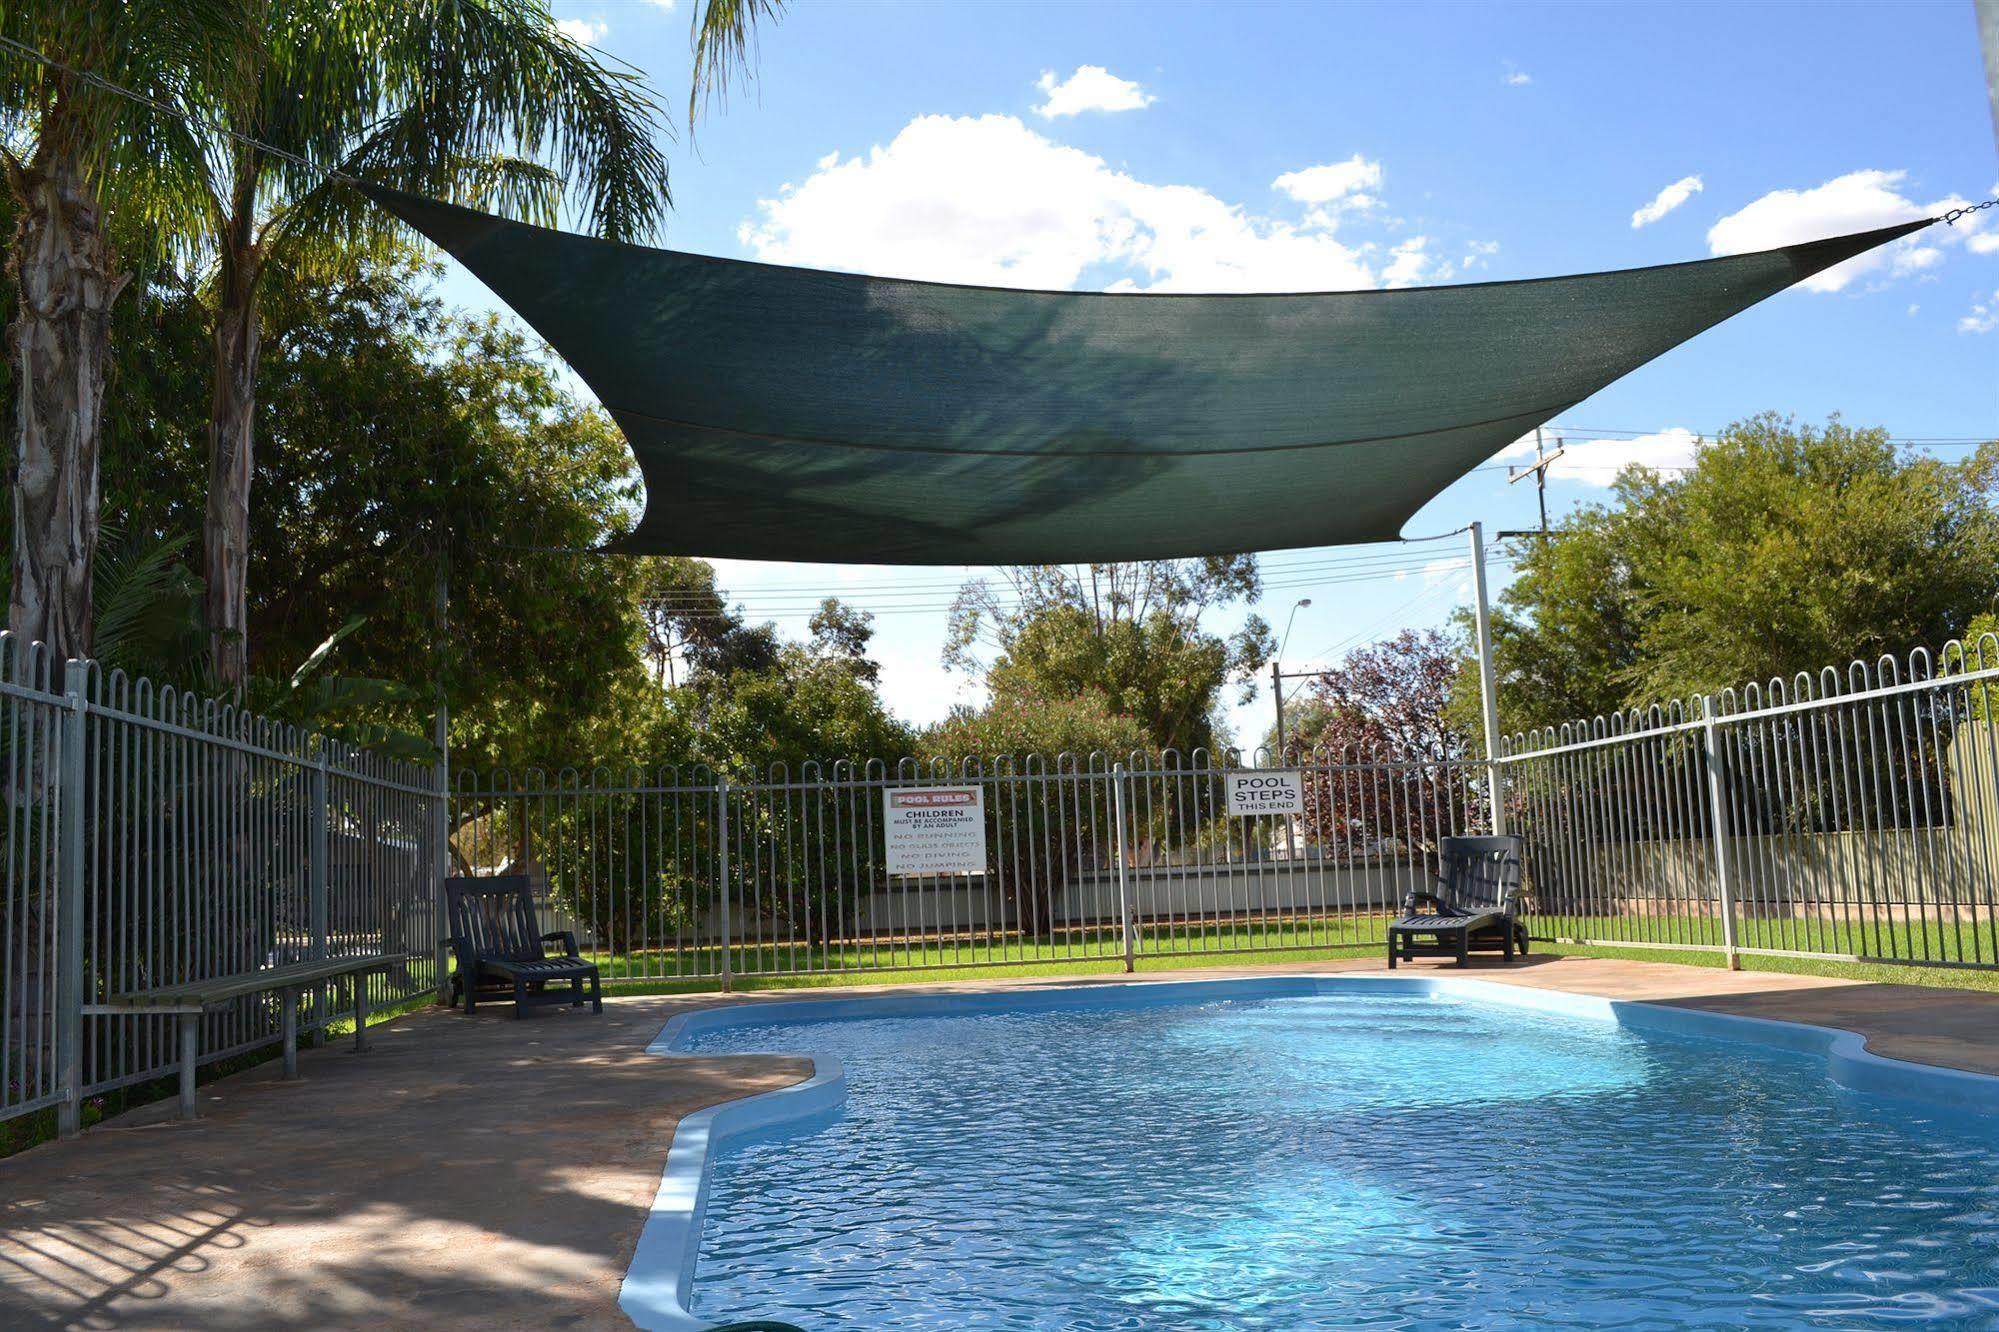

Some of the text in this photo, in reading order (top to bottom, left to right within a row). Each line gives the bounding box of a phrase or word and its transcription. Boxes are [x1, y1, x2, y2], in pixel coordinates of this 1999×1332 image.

[1238, 778, 1291, 789] POOL
[1235, 789, 1296, 801] STEPS
[906, 810, 963, 818] CHILDREN
